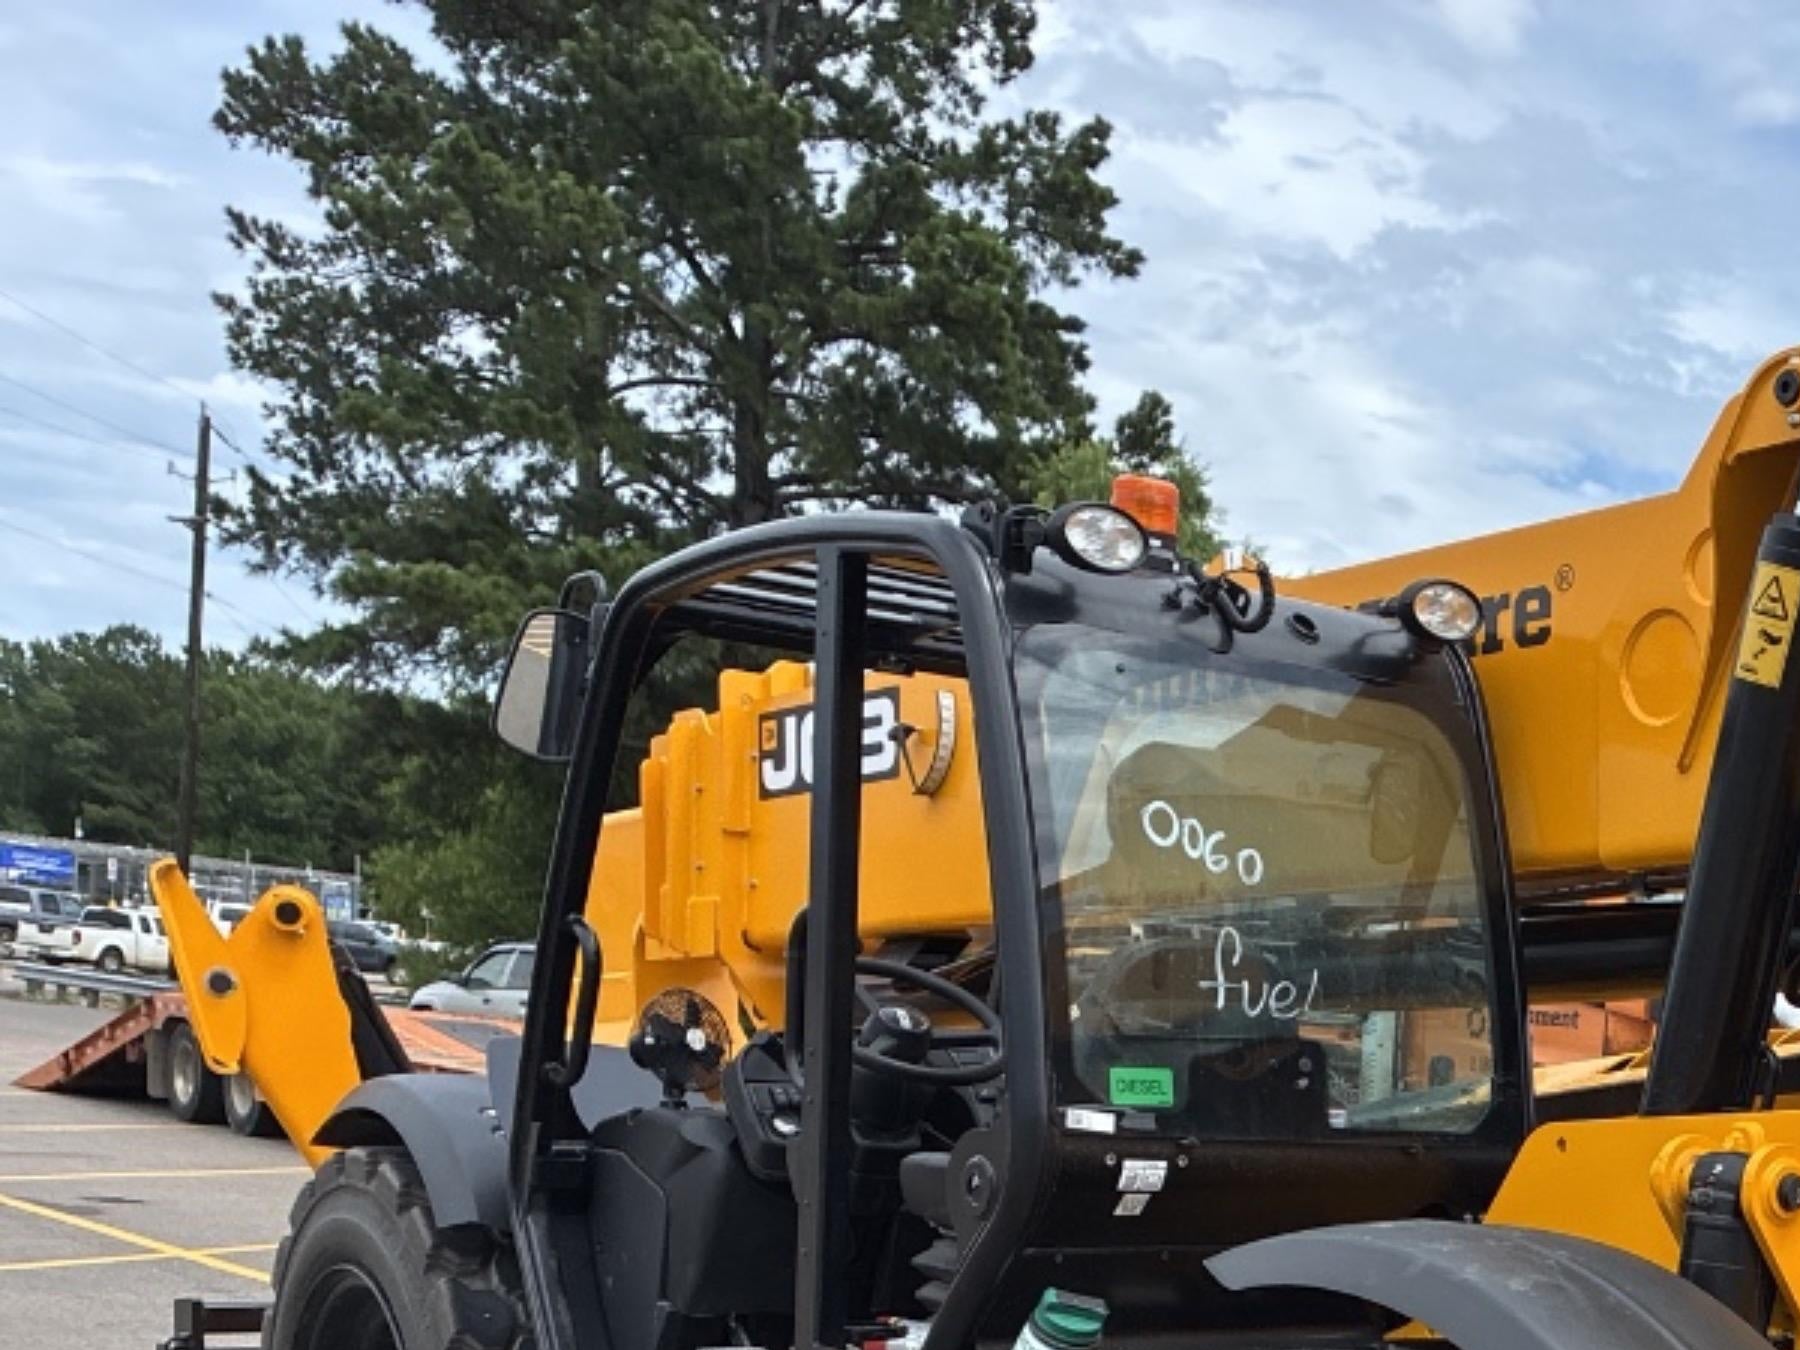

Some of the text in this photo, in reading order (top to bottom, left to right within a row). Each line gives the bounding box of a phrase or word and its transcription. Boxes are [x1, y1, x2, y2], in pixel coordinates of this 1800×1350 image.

[1141, 800, 1264, 885] 0060
[1198, 926, 1319, 1018] fuel
[1115, 1079, 1169, 1096] DIESEL
